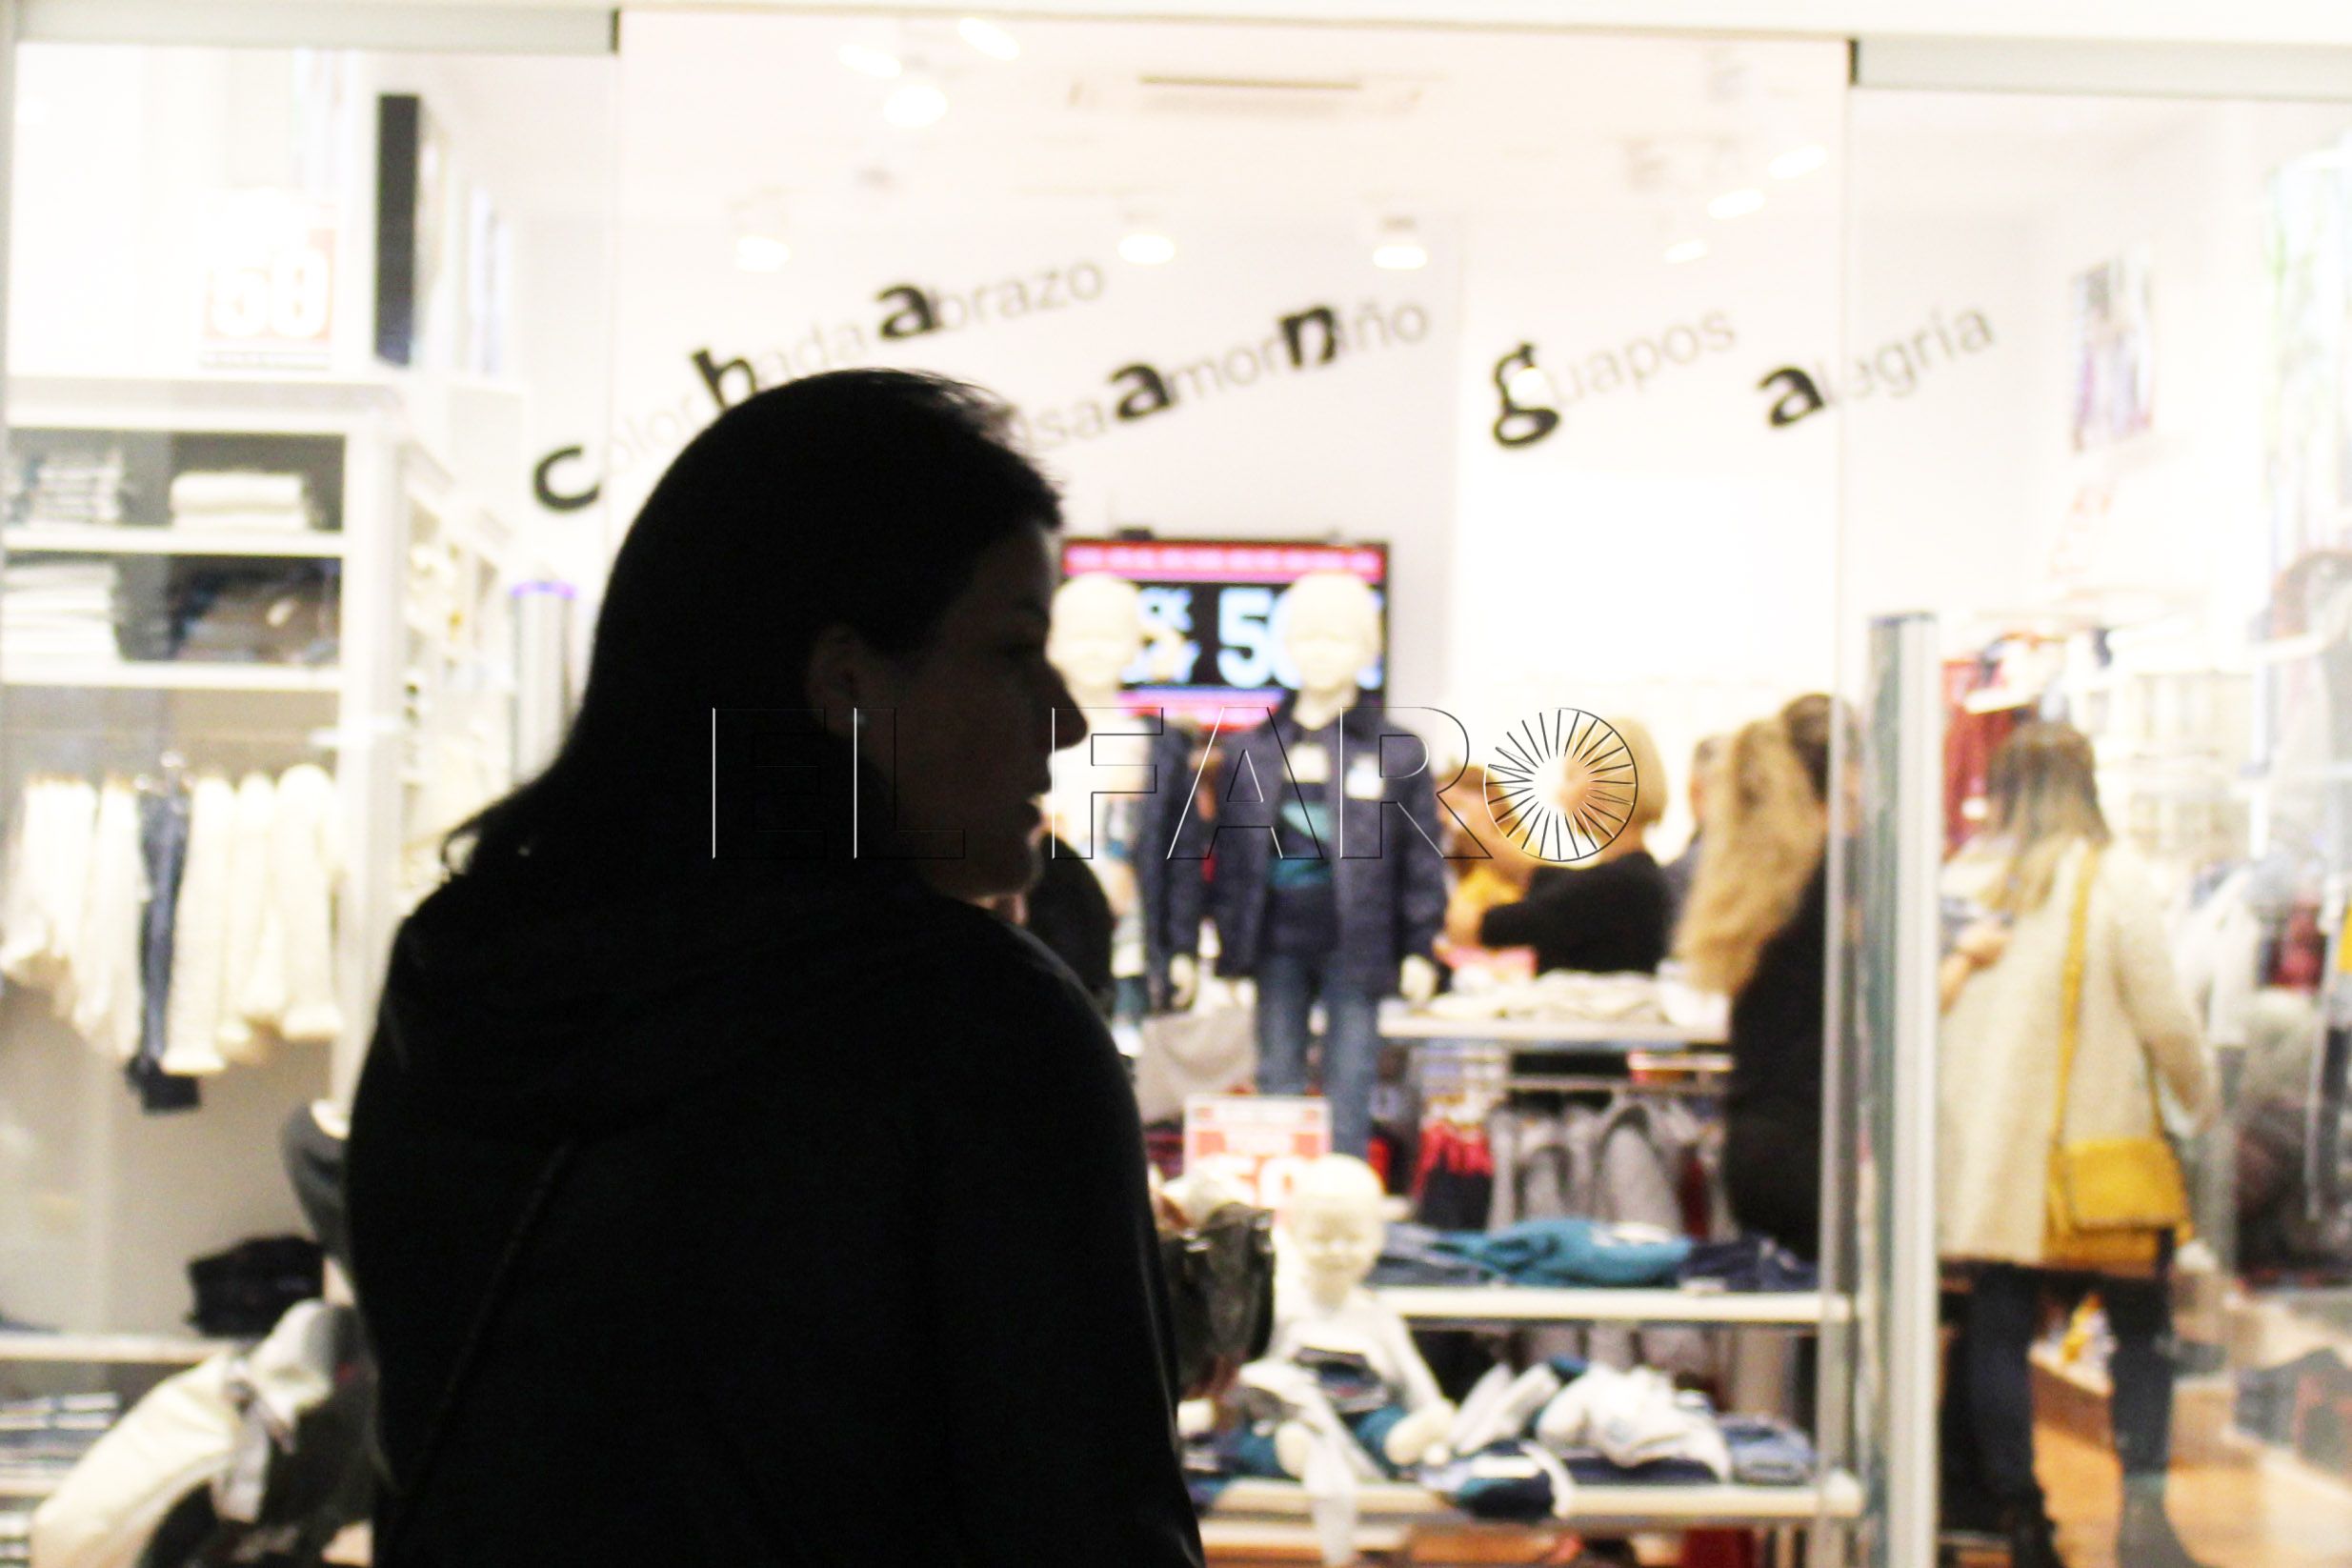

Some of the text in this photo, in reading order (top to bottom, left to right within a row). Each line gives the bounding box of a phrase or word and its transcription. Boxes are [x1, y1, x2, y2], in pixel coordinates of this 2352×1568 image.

[874, 260, 1105, 342] abrazo
[1107, 333, 1282, 424] amor
[1490, 308, 1739, 451] guapos
